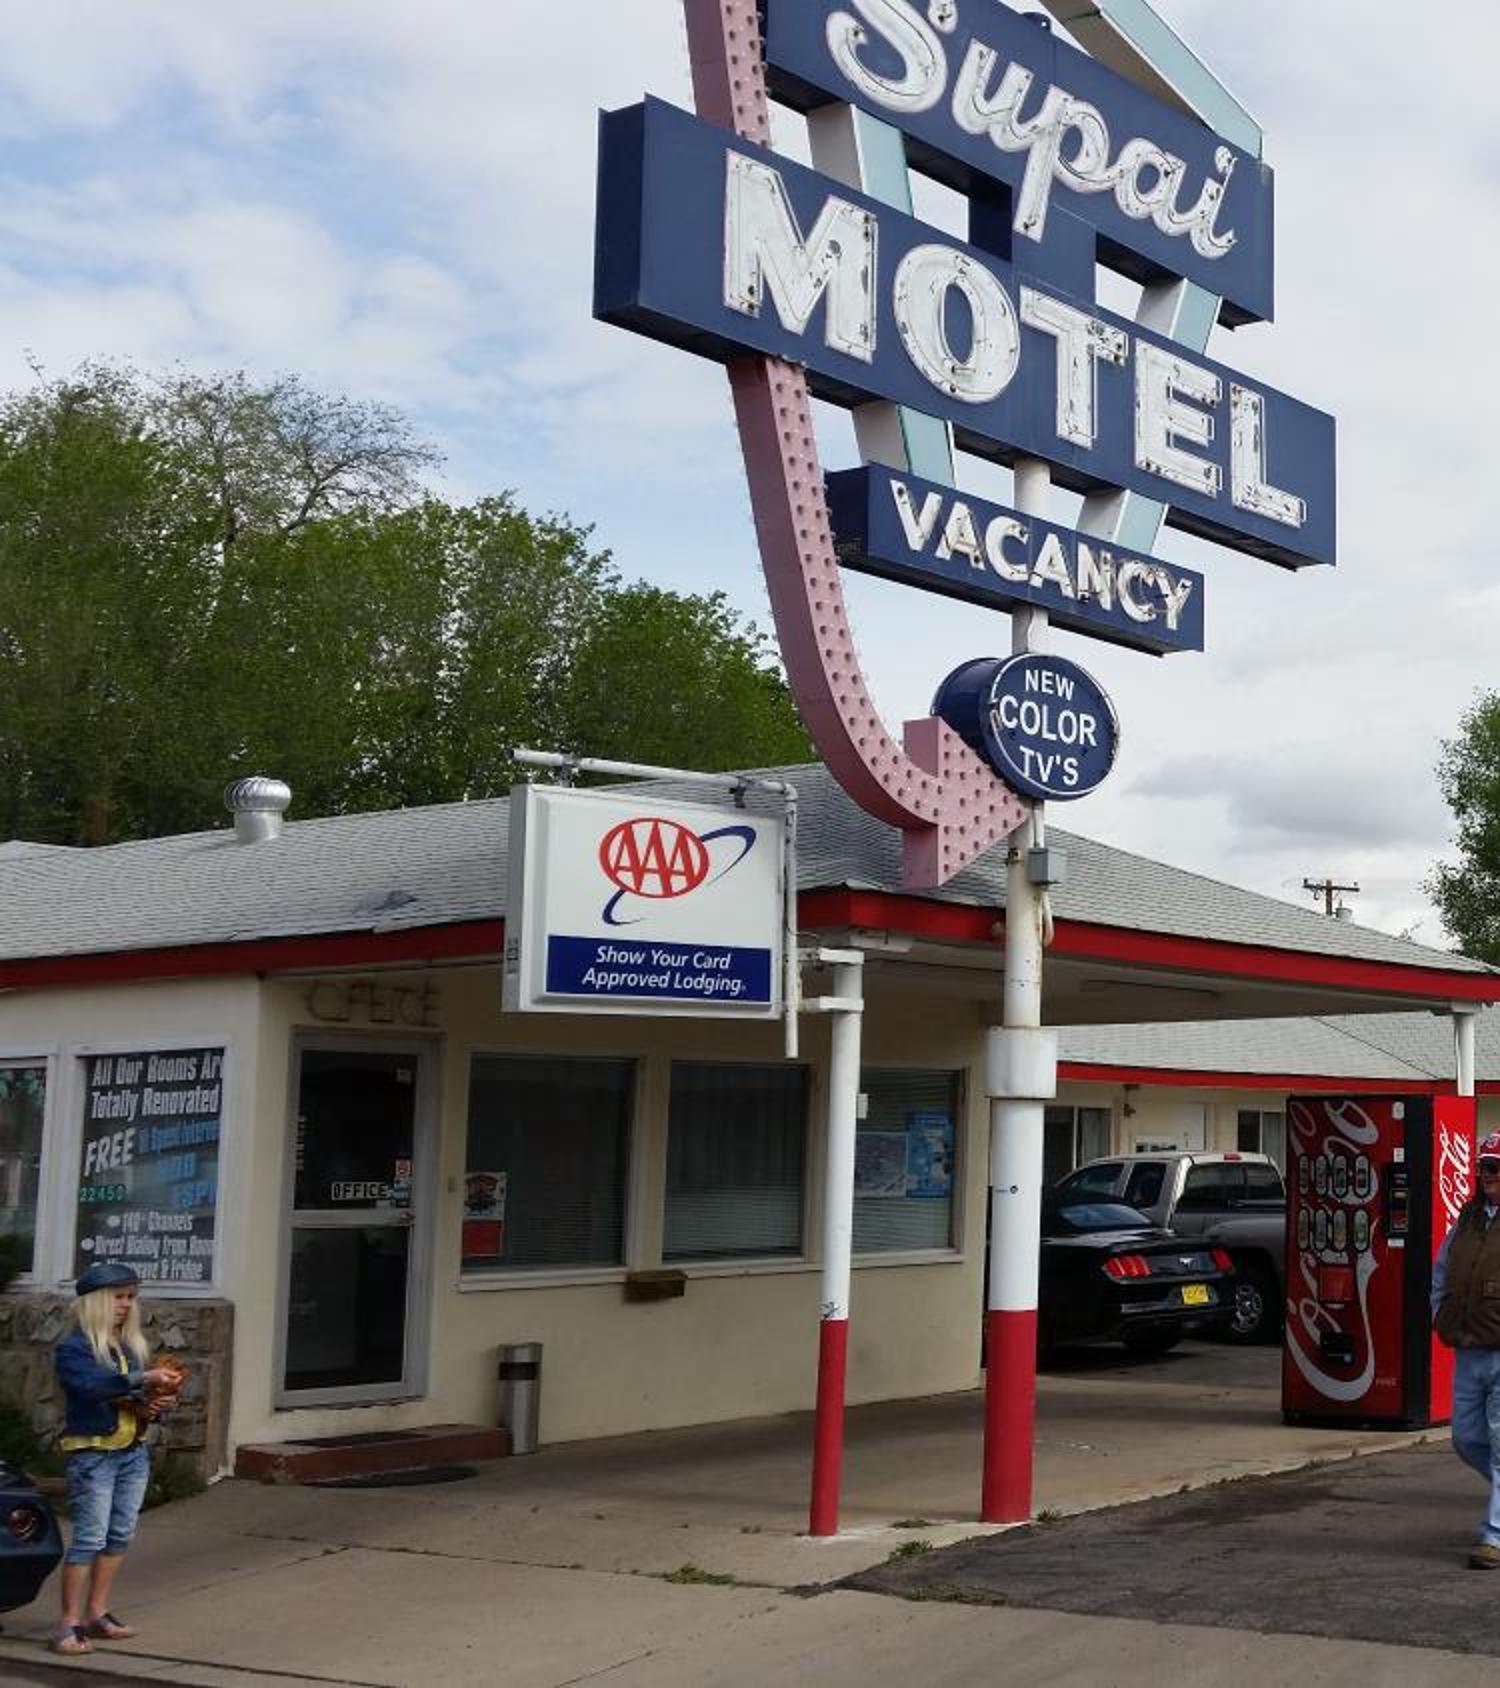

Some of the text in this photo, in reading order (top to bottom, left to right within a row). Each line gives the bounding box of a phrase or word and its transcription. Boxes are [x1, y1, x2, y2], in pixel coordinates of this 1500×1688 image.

[826, 0, 1238, 259] Supai
[723, 148, 1307, 529] MOTEL
[890, 480, 1193, 631] VACANCY
[1025, 669, 1074, 701] NEW
[1000, 694, 1098, 747] COLOR
[1019, 745, 1079, 786] TV'S
[610, 821, 701, 897] AAA
[582, 966, 669, 990] Approved
[596, 946, 730, 969] Show Your Card
[92, 1058, 113, 1087] All
[116, 1057, 143, 1084] Our
[147, 1055, 197, 1083] Rooms
[91, 1083, 220, 1121] Totally Renovated
[84, 1127, 136, 1177] FREE
[333, 1182, 388, 1198] OFFICE
